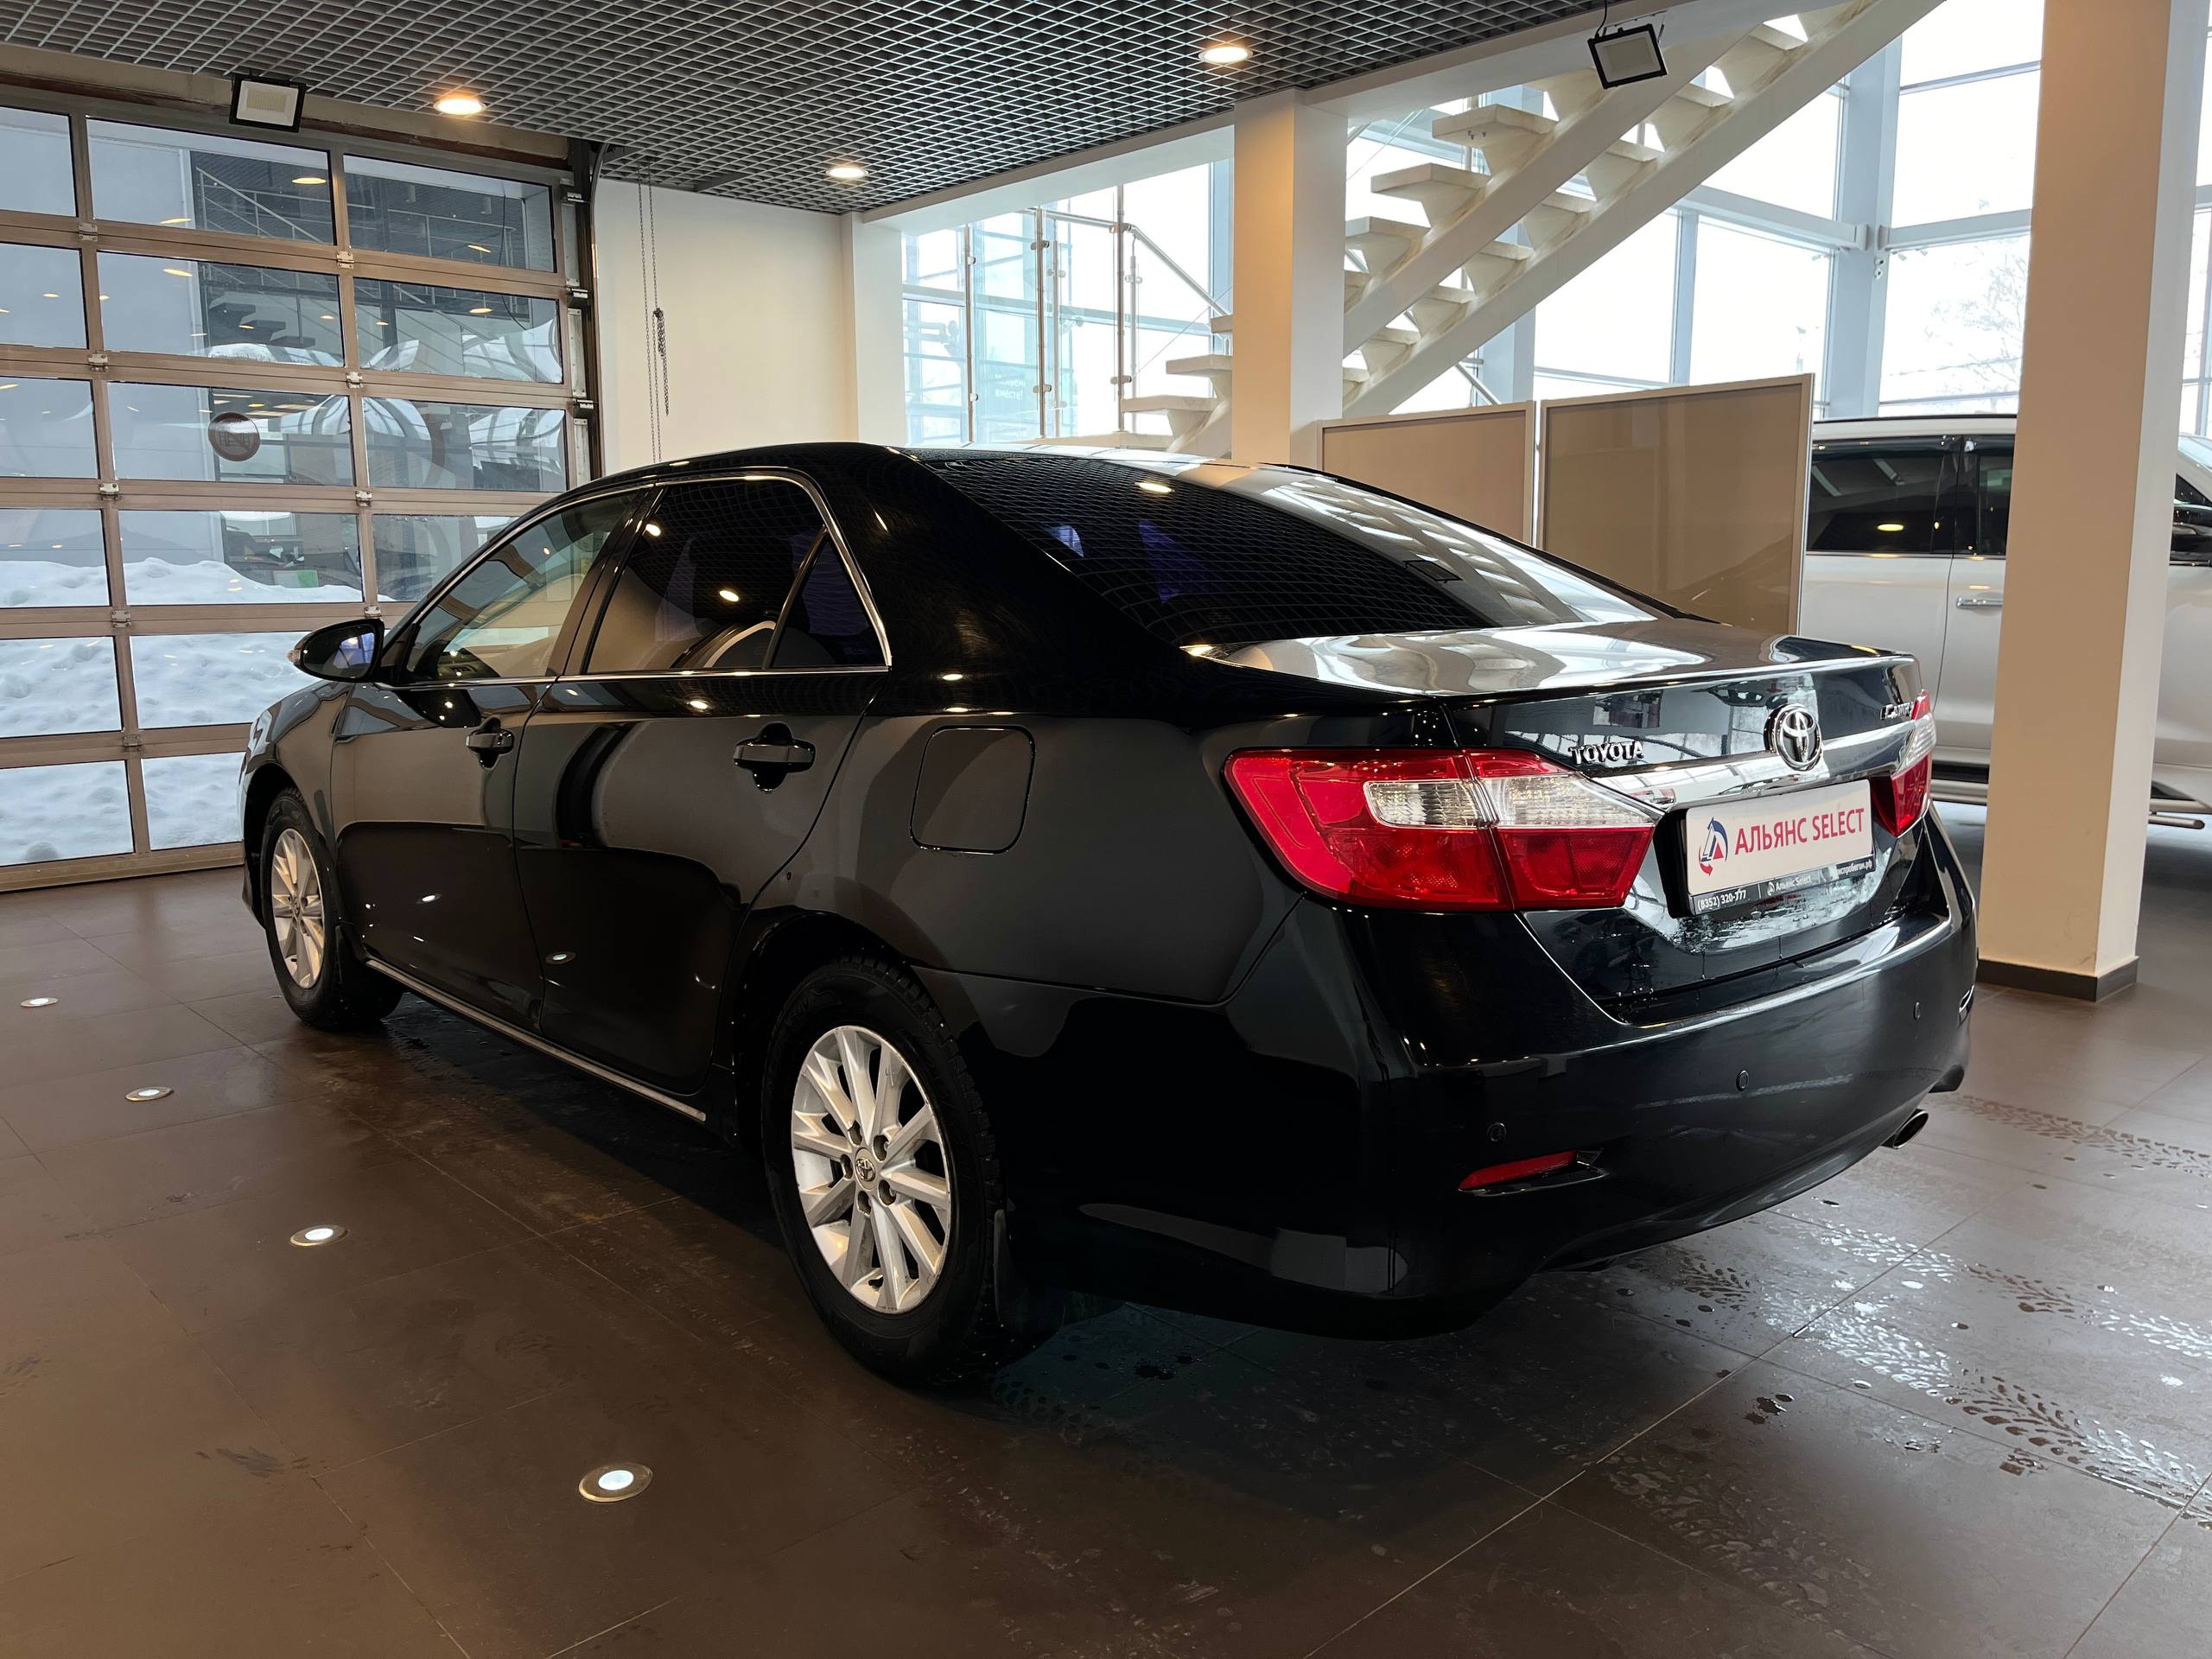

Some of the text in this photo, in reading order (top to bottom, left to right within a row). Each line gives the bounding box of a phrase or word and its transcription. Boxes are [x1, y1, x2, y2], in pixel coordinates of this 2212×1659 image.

[1569, 741, 1644, 765] TOYOTA
[1735, 808, 1865, 855] АЛЬЯНС SELECT
[1697, 895, 1720, 912] (8352)
